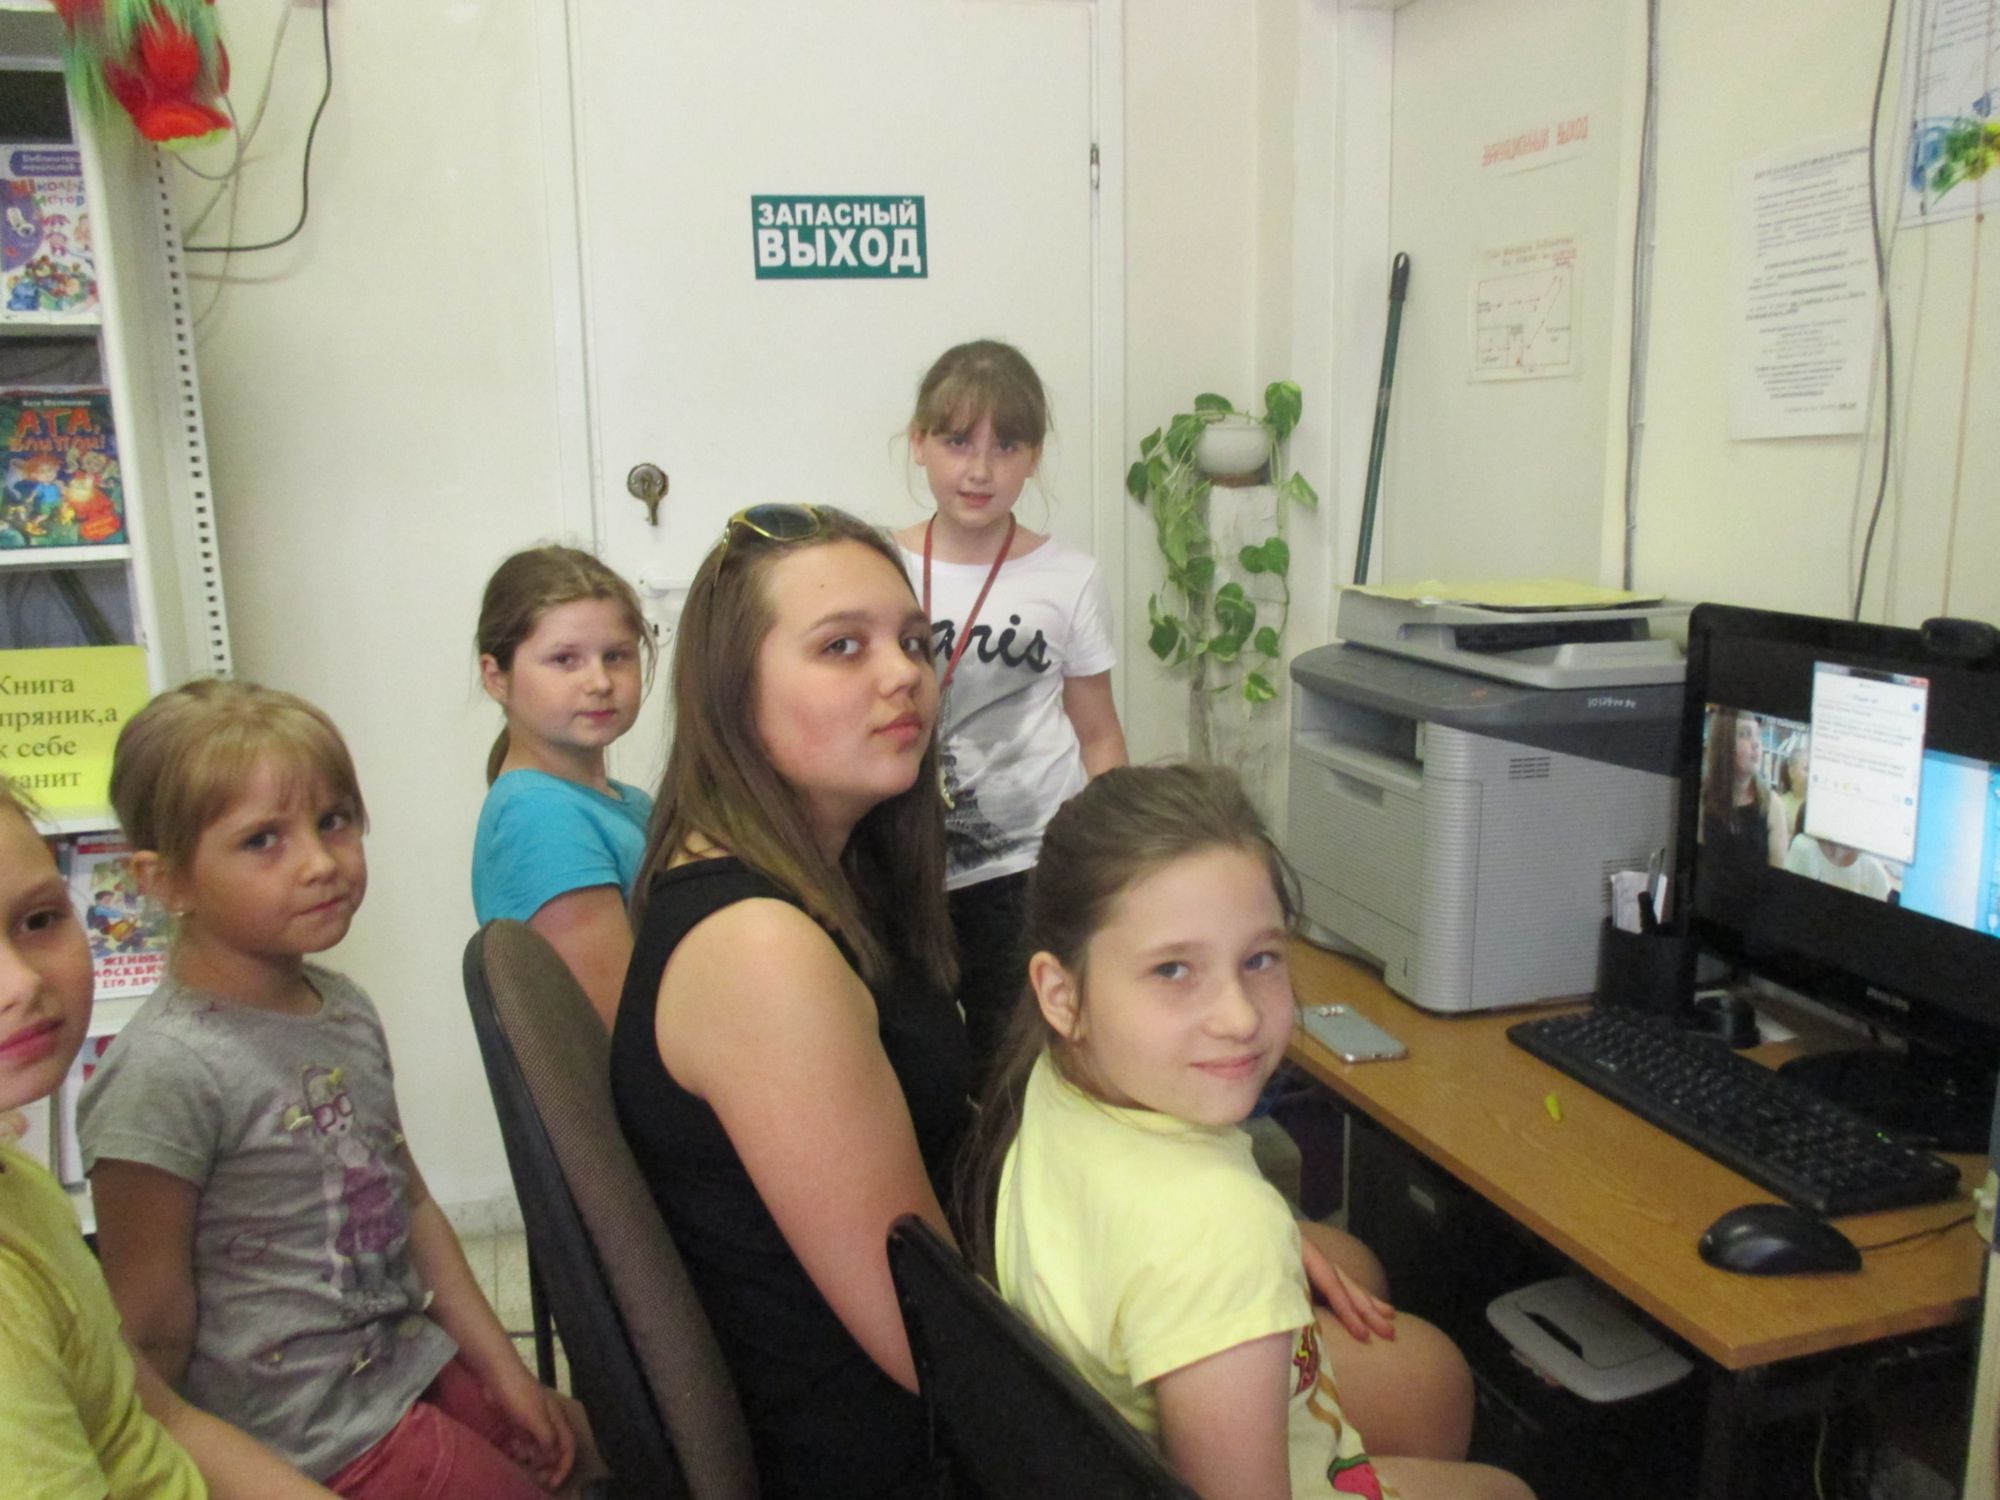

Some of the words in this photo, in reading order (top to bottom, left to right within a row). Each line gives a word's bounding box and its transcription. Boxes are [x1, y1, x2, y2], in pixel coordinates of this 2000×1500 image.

[758, 199, 917, 226] ЗАПАСНЫЙ
[757, 228, 922, 274] ВЫХОД
[17, 735, 77, 757] себе
